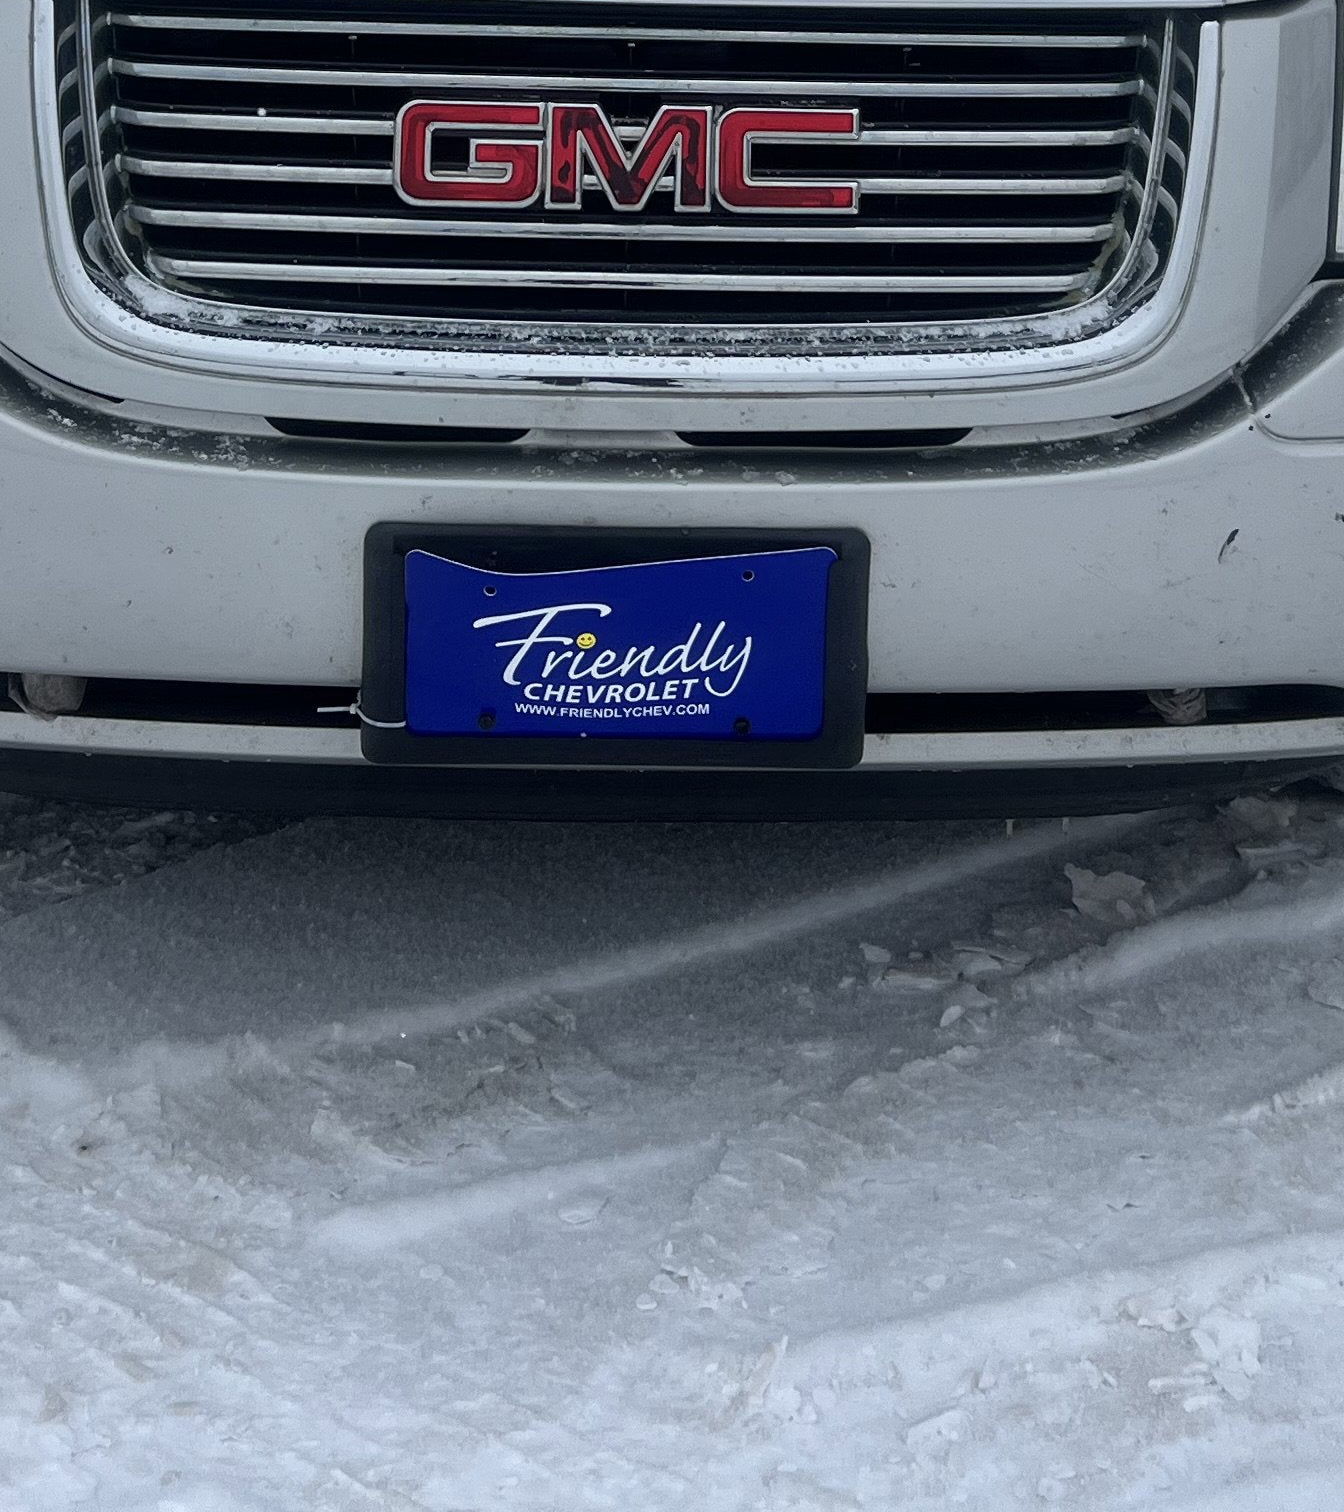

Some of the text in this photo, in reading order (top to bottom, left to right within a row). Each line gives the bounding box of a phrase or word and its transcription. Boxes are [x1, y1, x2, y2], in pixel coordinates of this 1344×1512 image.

[391, 98, 860, 214] GMC
[472, 602, 753, 698] Friendly
[513, 701, 711, 720] WWW.FRIENDLYCHEV.COM
[523, 677, 700, 705] CHEVROLET
